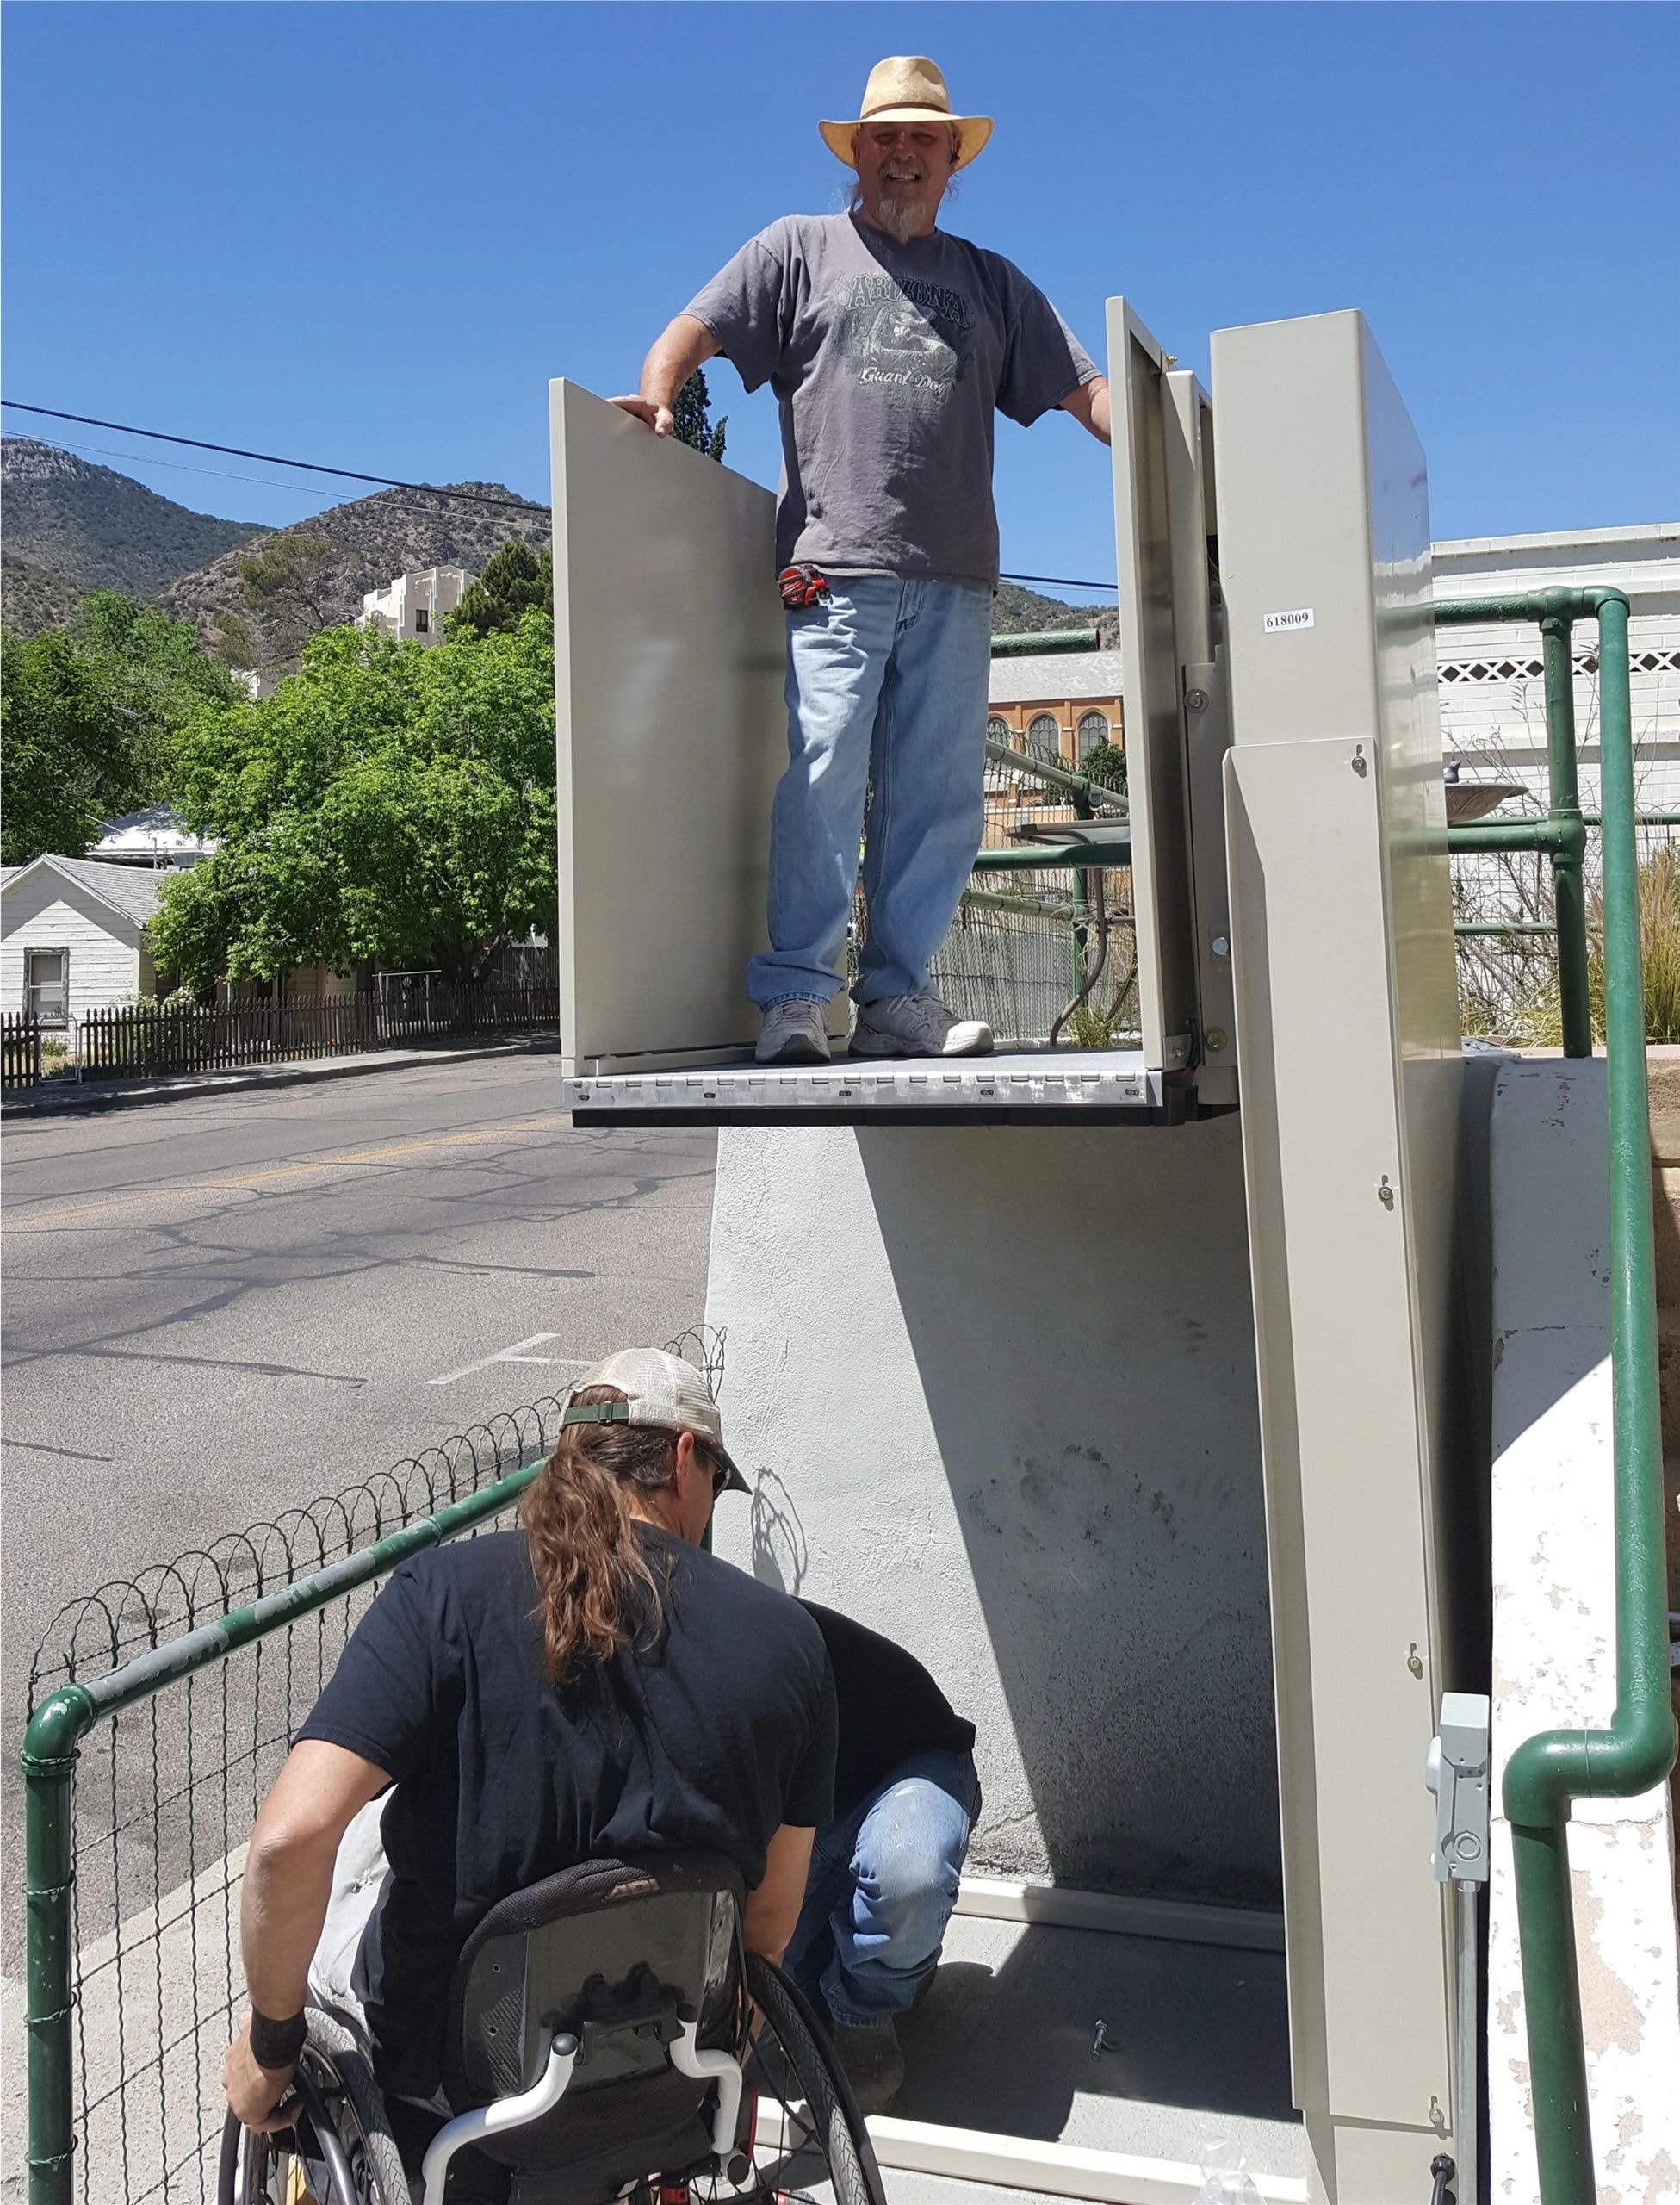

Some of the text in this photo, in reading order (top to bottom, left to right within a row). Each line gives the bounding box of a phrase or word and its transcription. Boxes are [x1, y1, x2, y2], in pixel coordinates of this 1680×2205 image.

[846, 274, 970, 328] ARIZONA
[859, 367, 948, 394] Guard Dog
[1266, 612, 1309, 628] 618009
